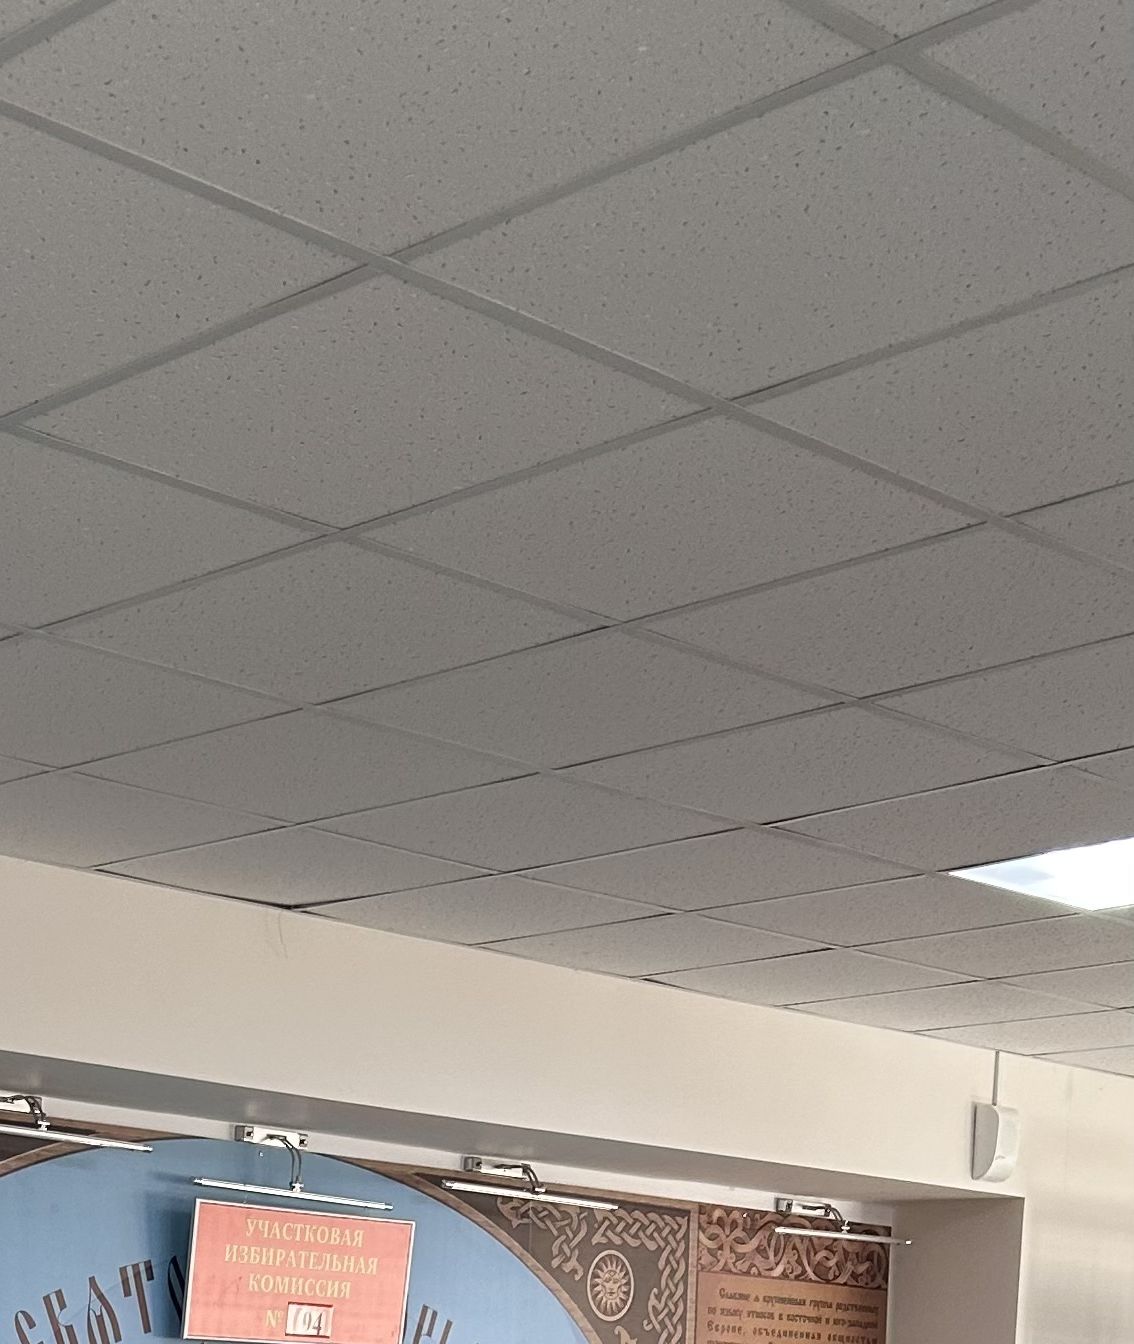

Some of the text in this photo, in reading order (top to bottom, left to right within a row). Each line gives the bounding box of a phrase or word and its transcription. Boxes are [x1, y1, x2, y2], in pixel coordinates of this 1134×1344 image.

[245, 1218, 364, 1249] УЧАСТКОВАЯ
[224, 1243, 379, 1276] ИЗБИРАТЕЛЬНАЯ
[248, 1273, 353, 1300] КОМИССИЯ
